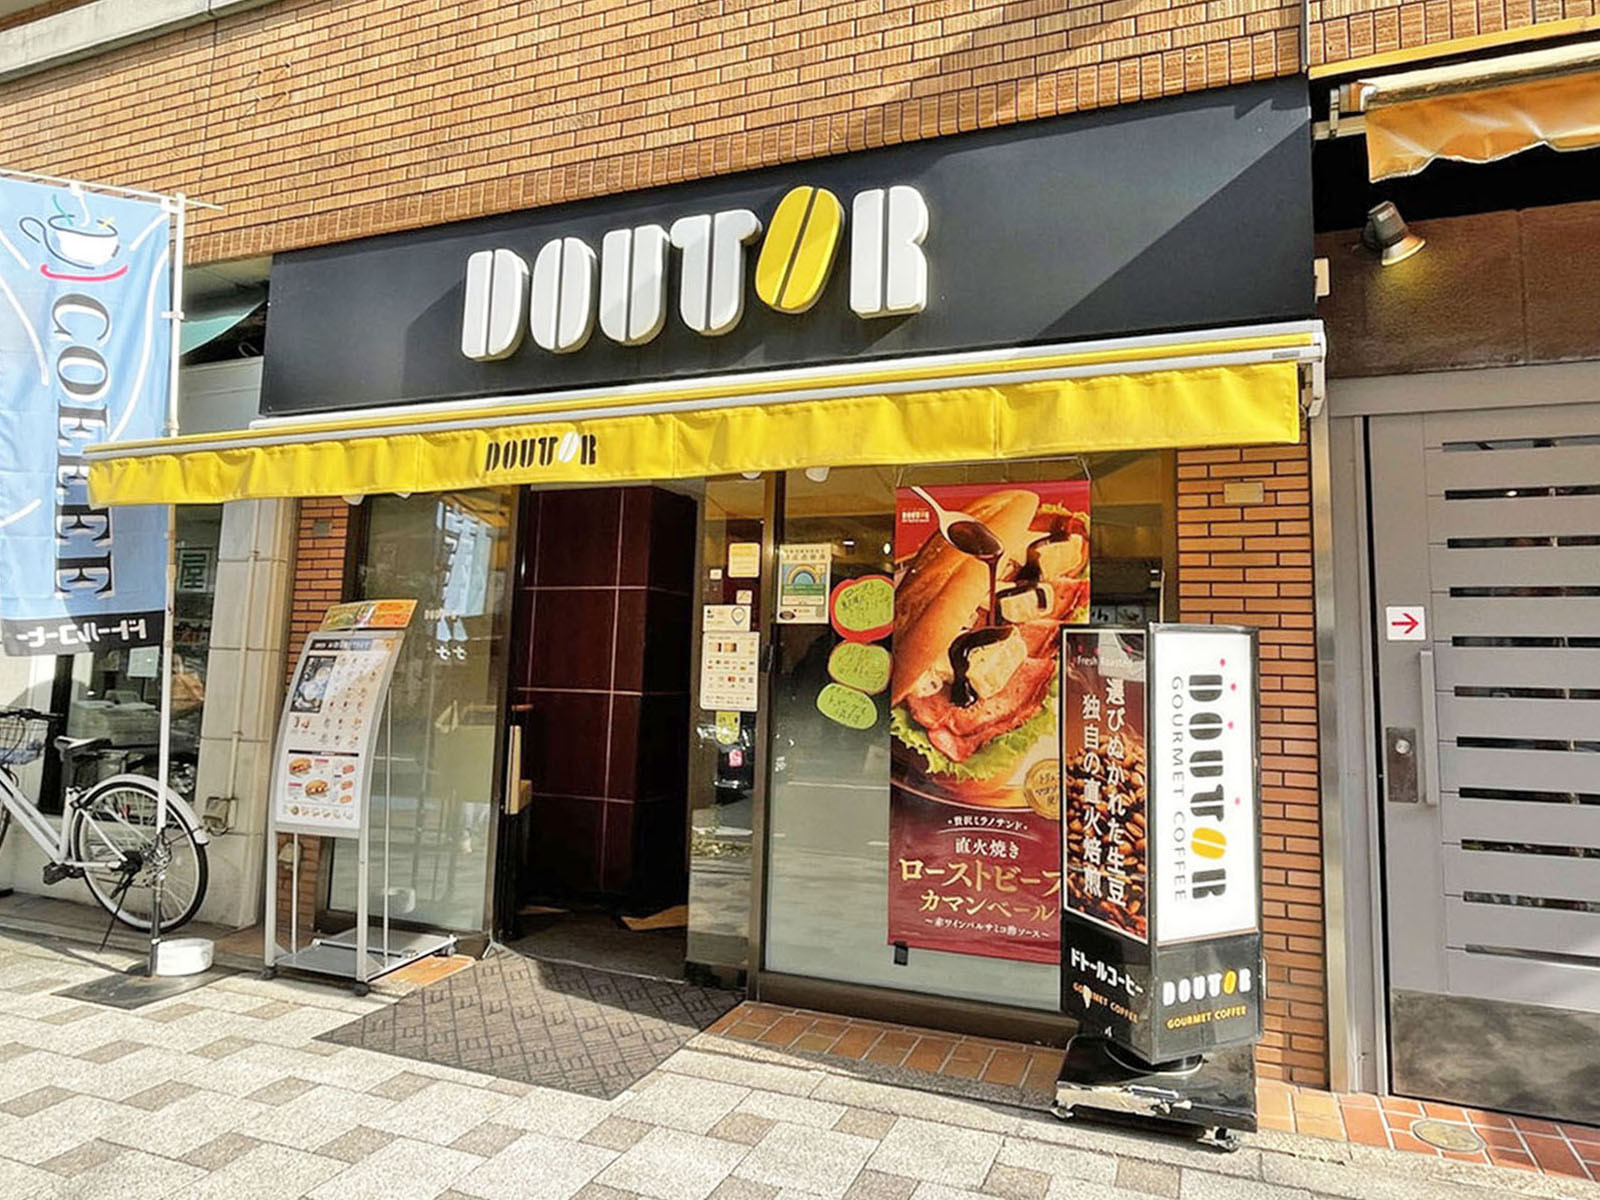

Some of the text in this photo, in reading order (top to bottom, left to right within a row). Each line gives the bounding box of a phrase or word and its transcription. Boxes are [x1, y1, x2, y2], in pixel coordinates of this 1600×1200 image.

[461, 185, 929, 361] DOUTOR
[485, 432, 596, 471] DOUTOR
[1082, 694, 1102, 898] 独自の直火焙煎
[1172, 676, 1187, 902] GOURMET COFFEE
[1189, 674, 1227, 900] DOUTOR
[955, 837, 1019, 860] 直火焼き
[919, 889, 1056, 922] カマンベール
[1071, 947, 1144, 997] ドトールコーヒー
[1162, 968, 1251, 1006] DOUTOR
[1166, 1005, 1248, 1030] GOURMET COFFEE
